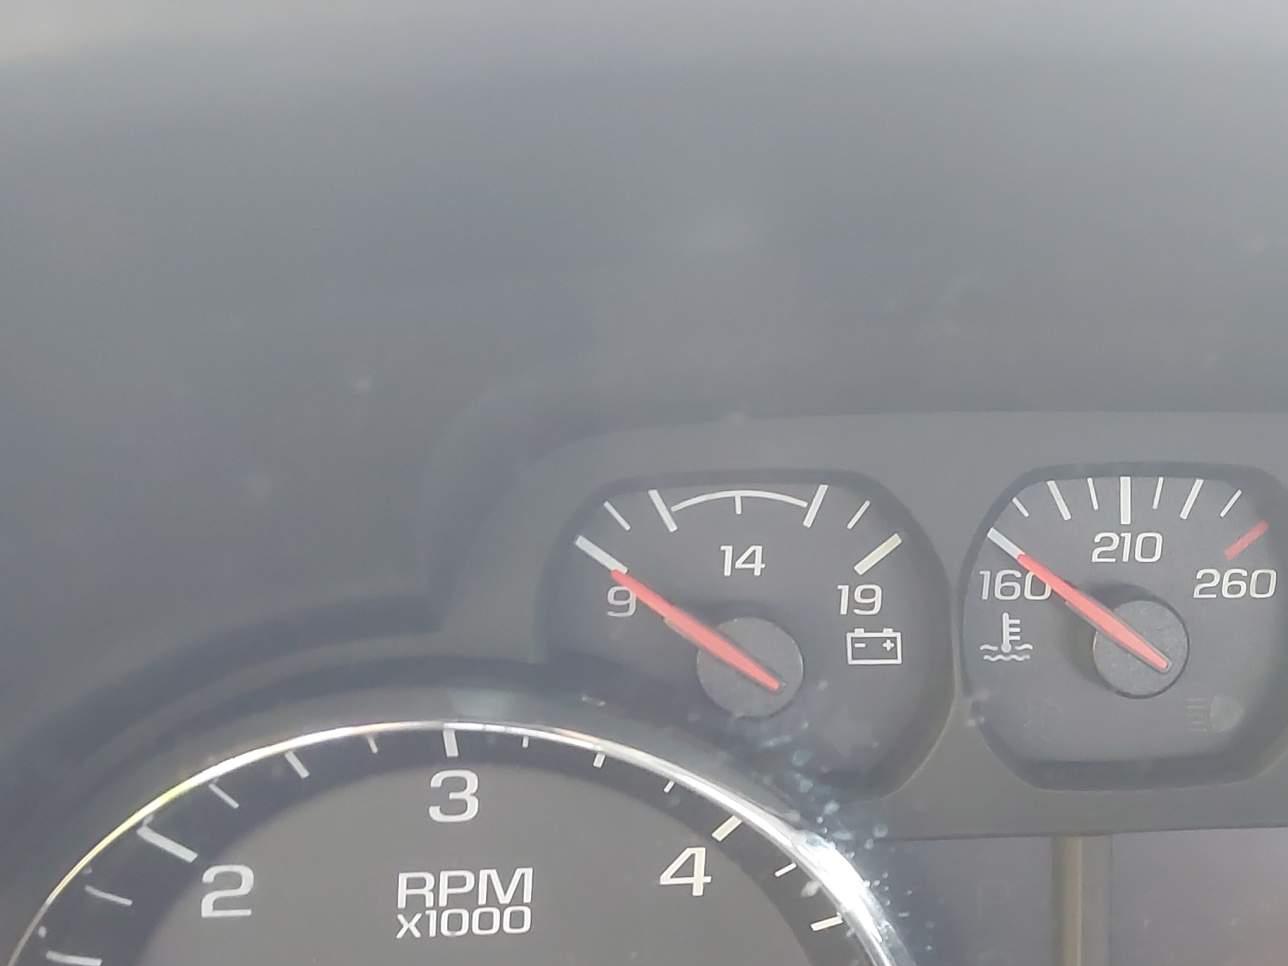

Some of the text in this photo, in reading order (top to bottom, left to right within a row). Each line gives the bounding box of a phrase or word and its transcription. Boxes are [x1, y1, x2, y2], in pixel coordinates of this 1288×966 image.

[720, 545, 766, 577] 14
[1091, 532, 1163, 563] 210
[837, 584, 883, 615] 19
[979, 570, 1052, 601] 160
[1193, 568, 1278, 599] 260
[607, 586, 637, 617] 9
[428, 769, 479, 823] 3
[659, 847, 712, 896] 4
[200, 864, 255, 918] 2
[397, 867, 533, 909] RPM
[396, 905, 532, 939] x1000
